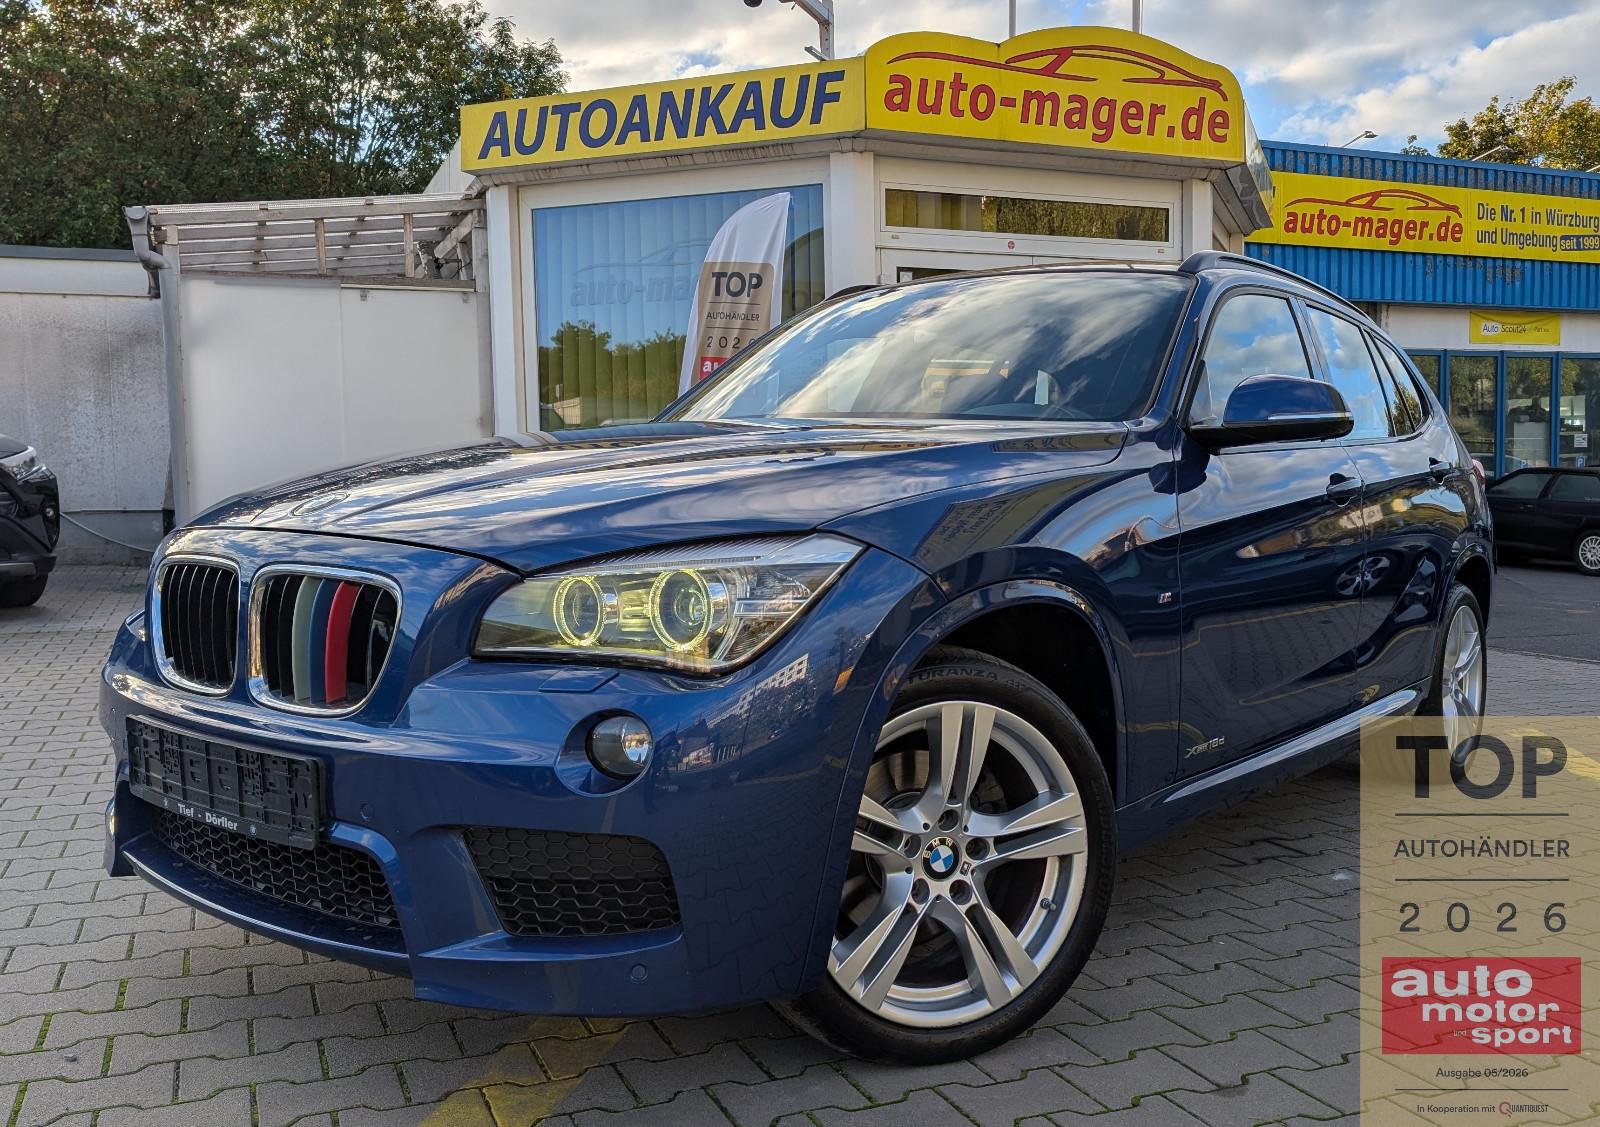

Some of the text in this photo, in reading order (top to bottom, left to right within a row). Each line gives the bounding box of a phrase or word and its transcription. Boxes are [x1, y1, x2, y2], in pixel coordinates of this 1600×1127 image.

[478, 70, 845, 160] AUTOANKAUF
[884, 72, 1230, 143] auto-mager.de
[1284, 209, 1463, 246] auto-mager.de
[1477, 202, 1600, 233] Die Nr. 1 in Würzburg
[1477, 227, 1600, 252] und Umgebung seit 1999
[711, 271, 763, 298] TOP
[706, 310, 760, 322] AUTOHÄNDLER
